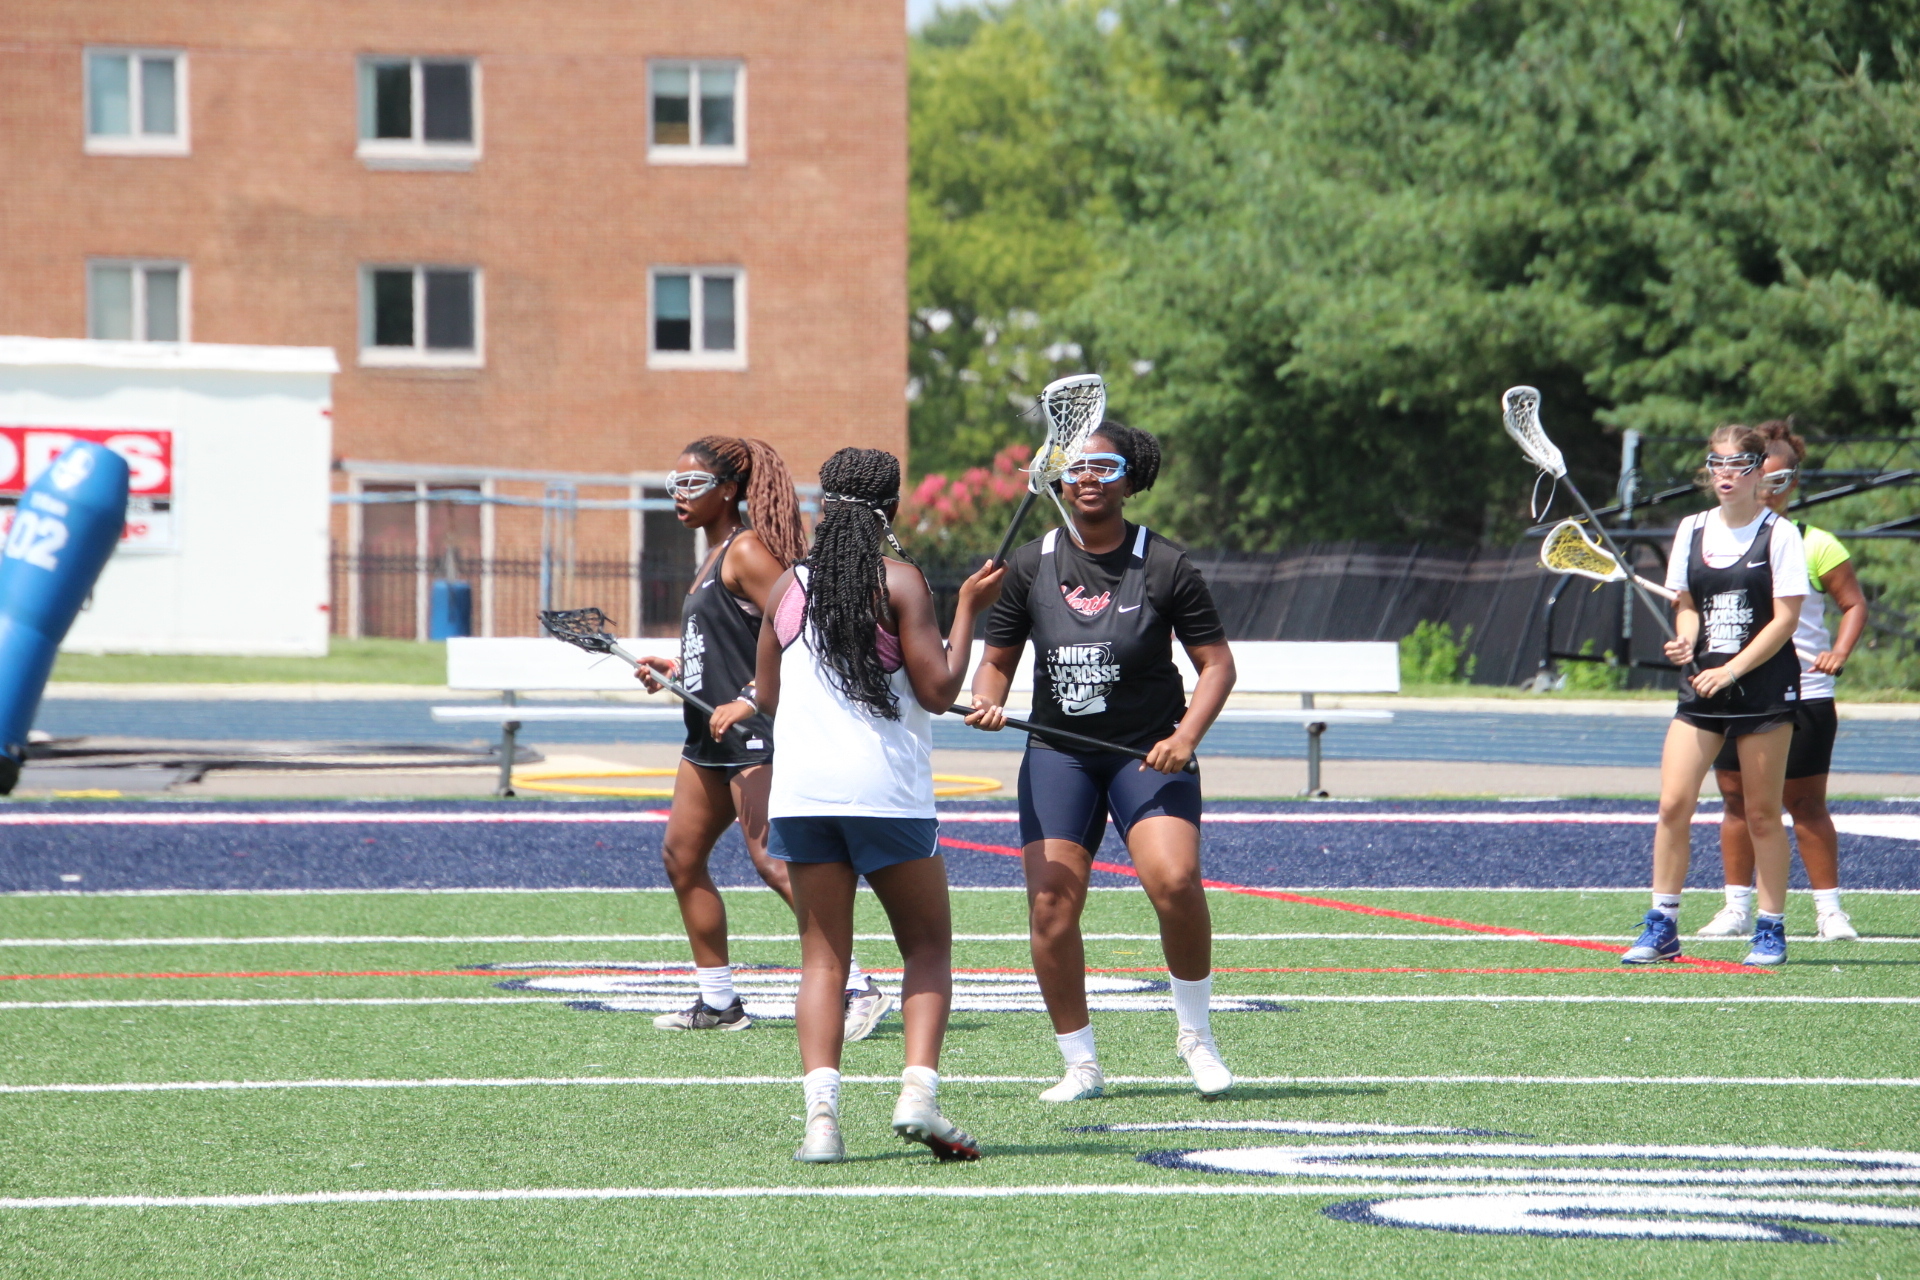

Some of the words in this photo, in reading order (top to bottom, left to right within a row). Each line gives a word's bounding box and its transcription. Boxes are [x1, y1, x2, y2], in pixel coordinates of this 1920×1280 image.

[4, 509, 69, 572] 02
[886, 533, 902, 553] STX
[1057, 646, 1102, 665] NIKE
[1047, 664, 1121, 684] LACROSSE
[1057, 682, 1106, 702] CAMP
